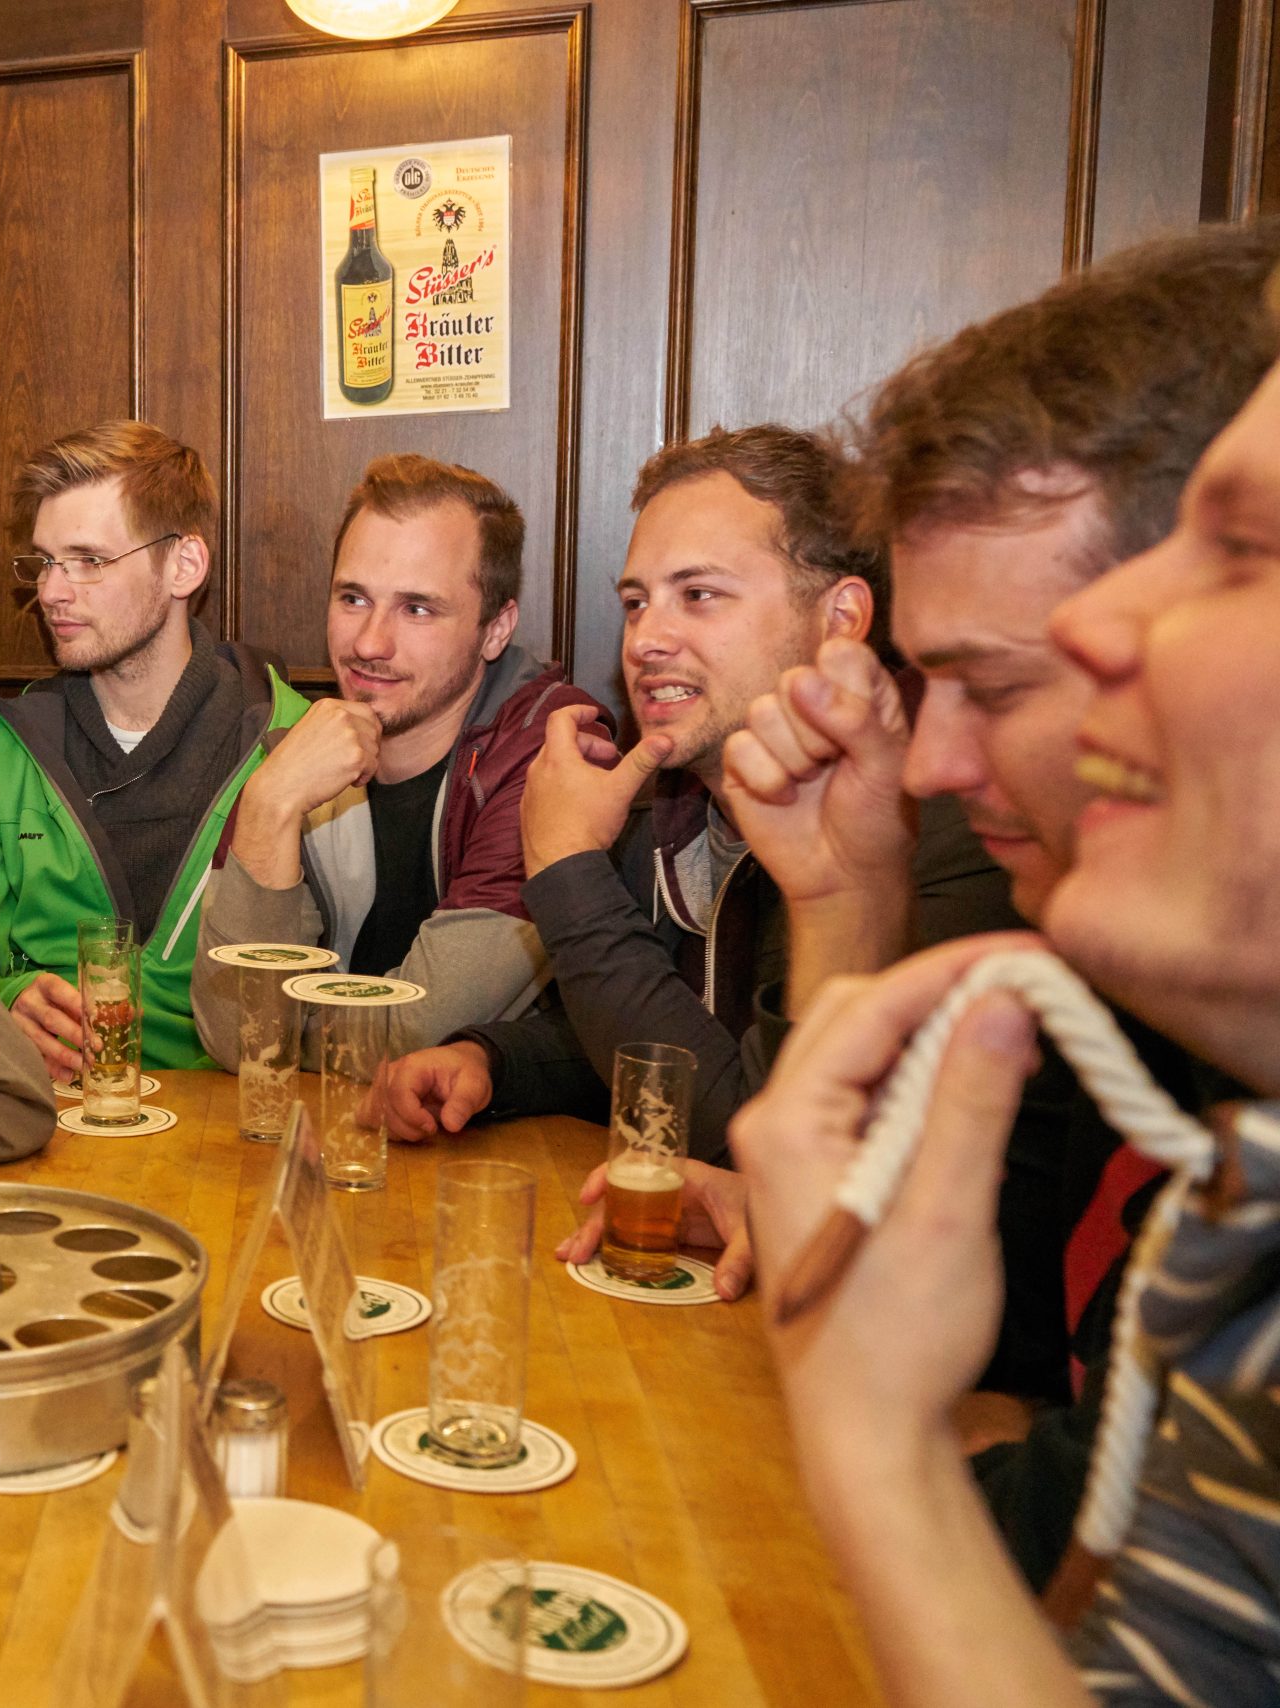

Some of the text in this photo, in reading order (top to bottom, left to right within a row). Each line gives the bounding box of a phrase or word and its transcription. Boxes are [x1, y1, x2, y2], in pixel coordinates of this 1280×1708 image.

[405, 249, 494, 304] Stüsser's
[405, 312, 494, 341] Kräuter
[415, 341, 484, 370] Bitter
